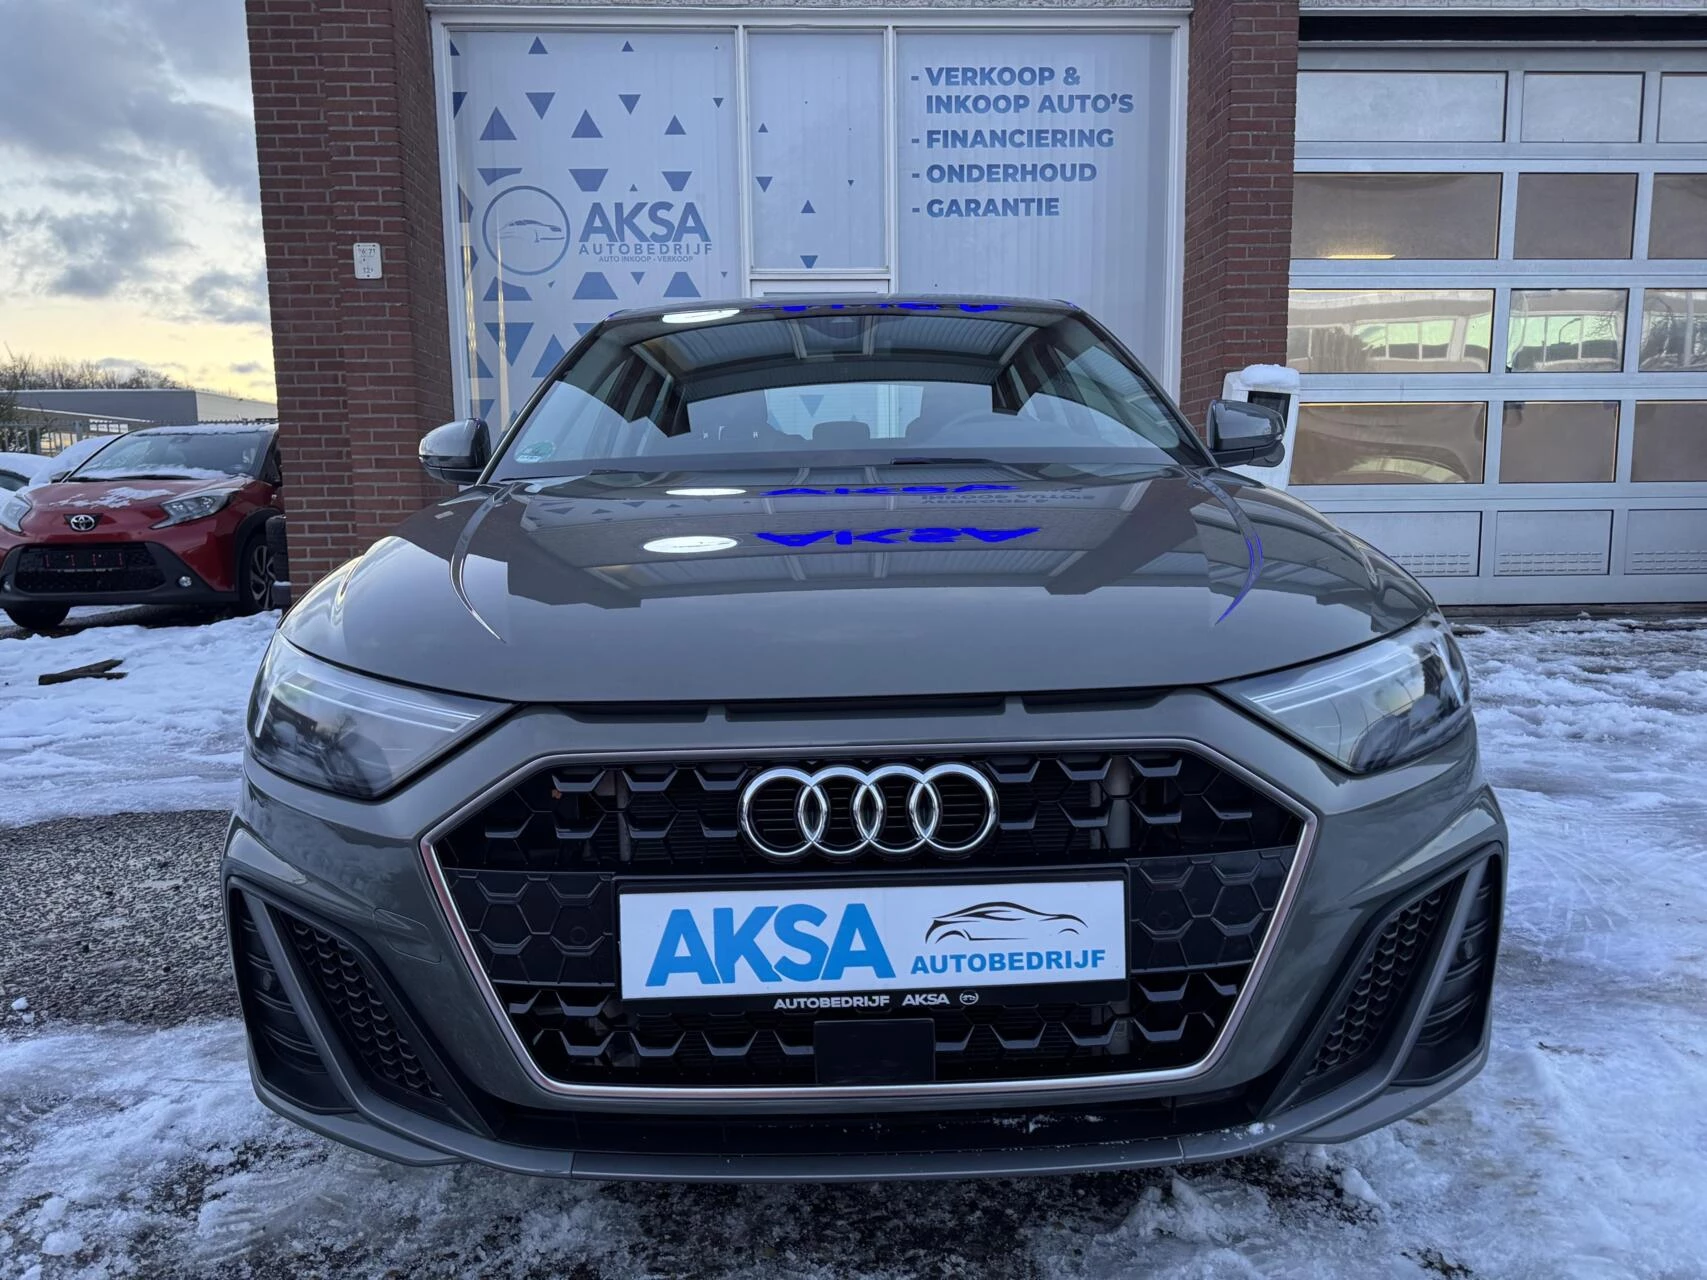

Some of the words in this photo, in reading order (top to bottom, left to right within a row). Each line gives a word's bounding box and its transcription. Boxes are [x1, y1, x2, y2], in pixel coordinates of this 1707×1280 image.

[925, 67, 1055, 86] VERKOOP
[1063, 67, 1080, 86] &
[926, 95, 1030, 114] INKOOP
[1037, 93, 1134, 114] AUTO'S
[926, 129, 1114, 149] FINANCIERING
[926, 163, 1097, 183] ONDERHOUD
[926, 198, 1060, 218] GARANTIE
[579, 201, 712, 243] AKSA
[579, 243, 713, 255] AUTOBEDRIJF
[599, 255, 620, 263] AUTO
[621, 255, 651, 263] INKOOP
[657, 255, 693, 263] VERKOOP
[645, 903, 896, 986] AKSA
[910, 950, 1106, 974] AUTOBEDRIJF
[774, 996, 890, 1009] AUTOBEDRIJF
[902, 993, 950, 1005] AKSA
